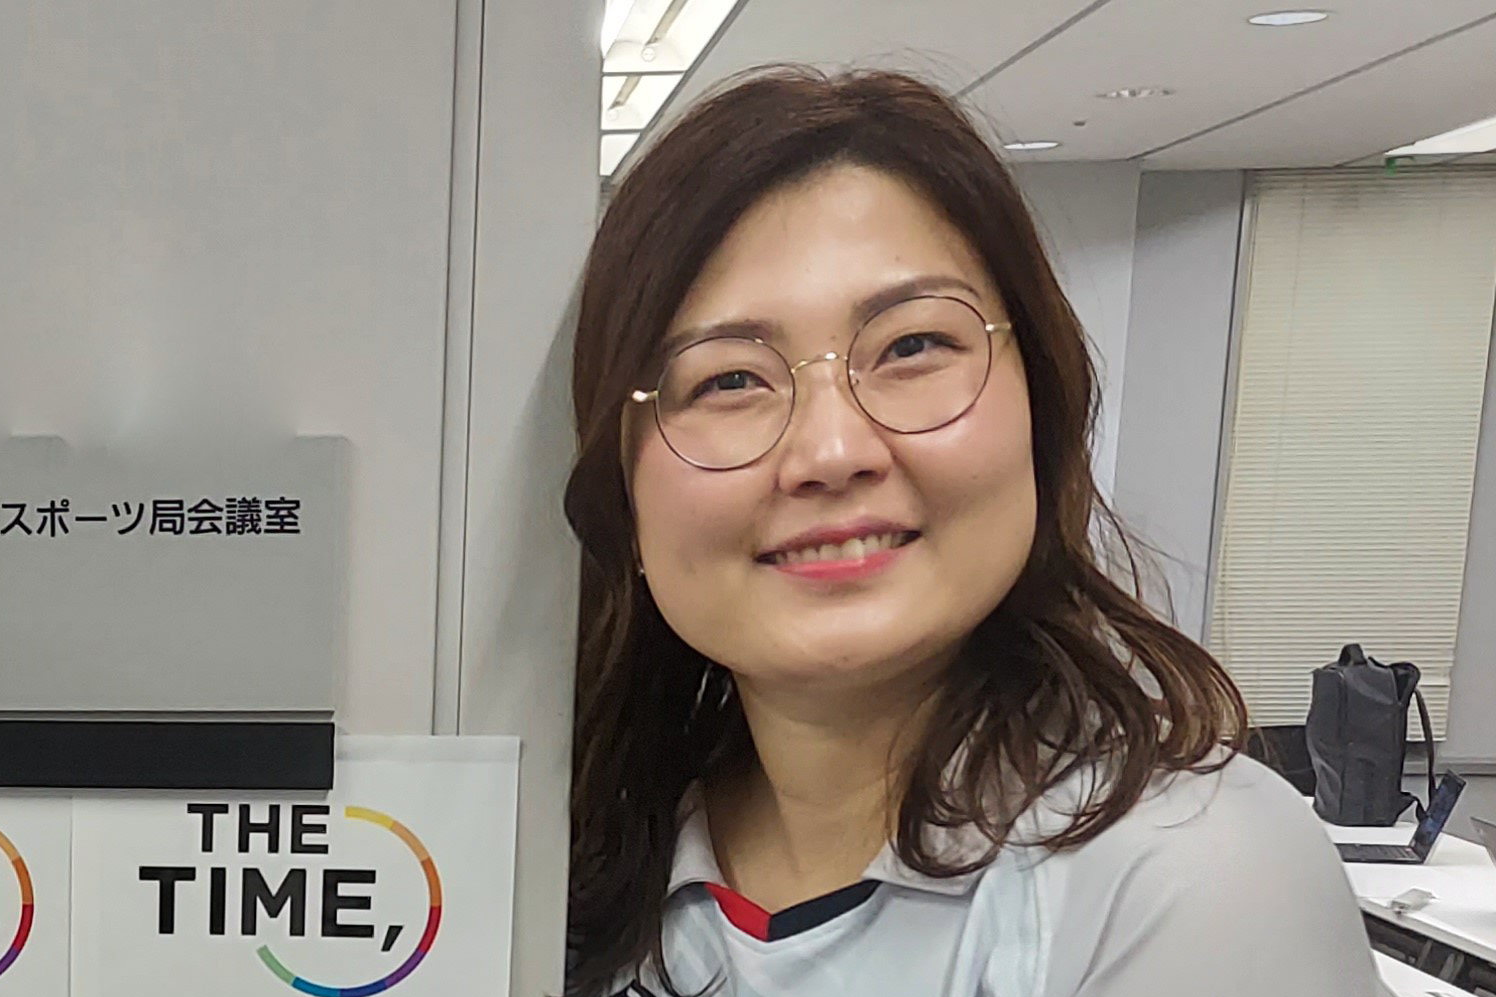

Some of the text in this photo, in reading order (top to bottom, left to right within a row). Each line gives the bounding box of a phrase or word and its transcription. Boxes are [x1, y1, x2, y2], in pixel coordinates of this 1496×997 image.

[0, 496, 301, 538] スポーツ局会議室
[187, 803, 331, 855] THE
[139, 865, 405, 952] TIME,
